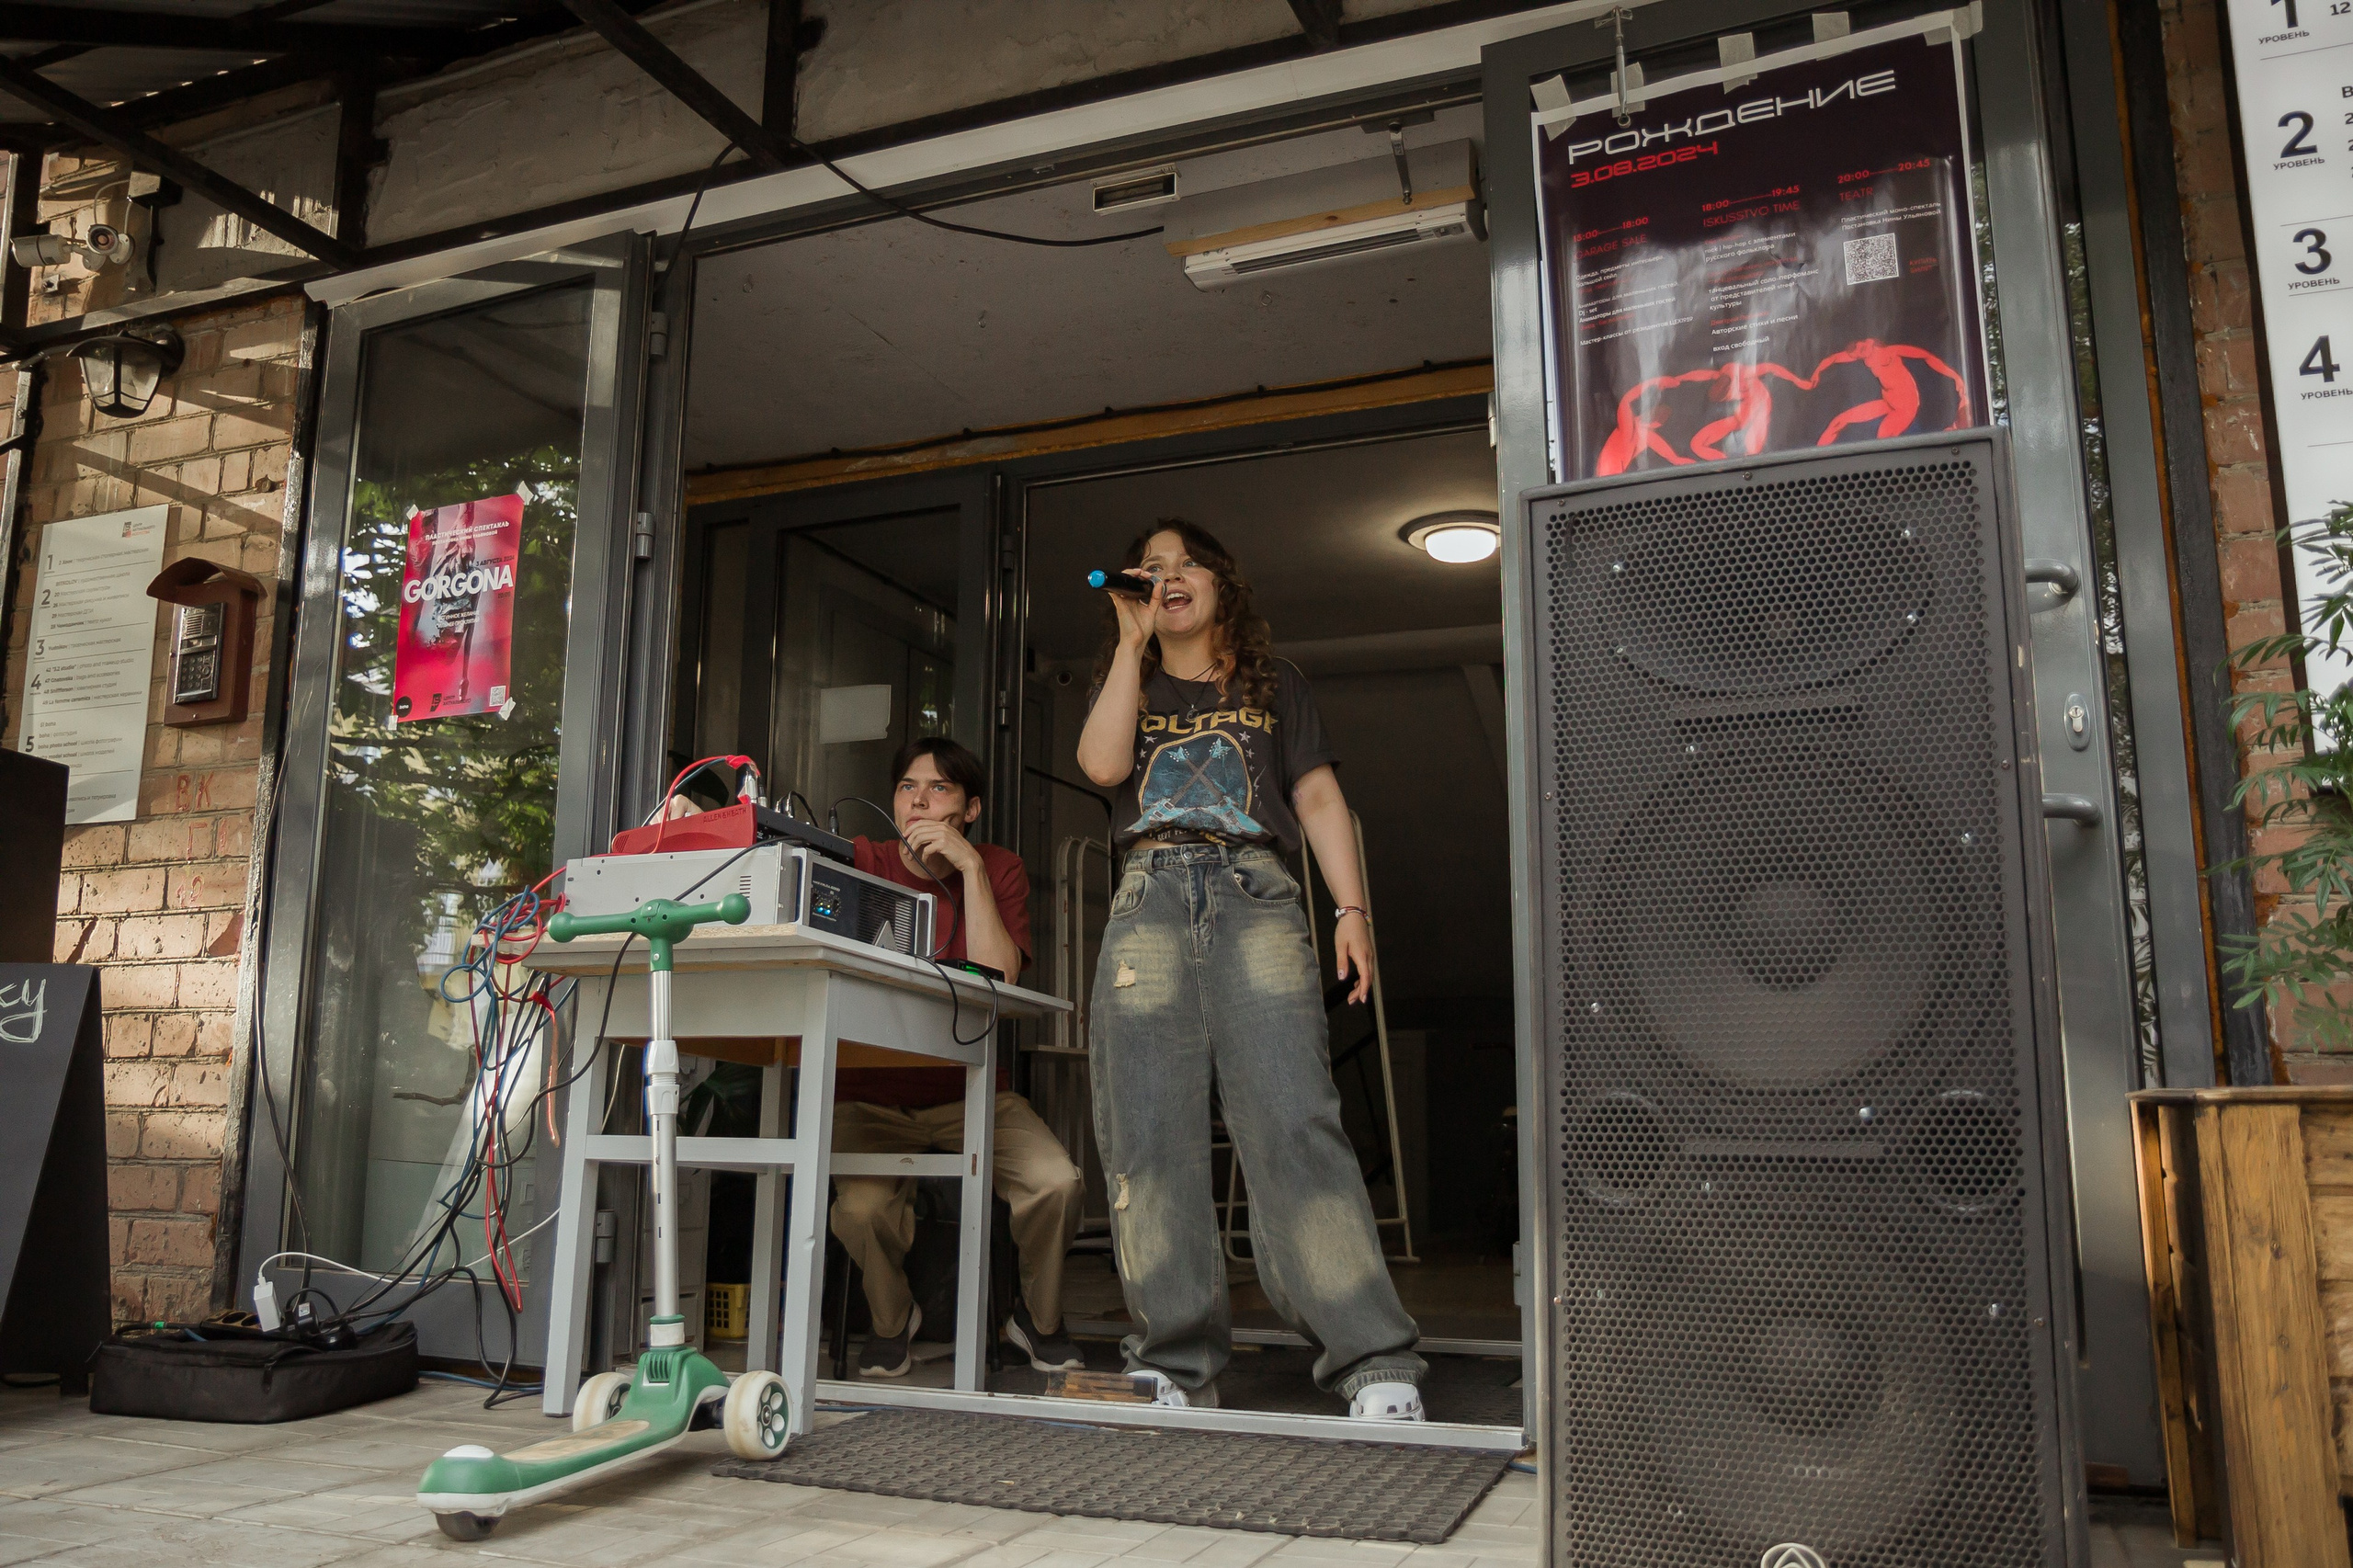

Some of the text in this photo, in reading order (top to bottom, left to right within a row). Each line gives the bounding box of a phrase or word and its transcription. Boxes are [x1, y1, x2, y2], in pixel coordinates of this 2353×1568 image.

[2269, 0, 2299, 28] 1
[2329, 2, 2351, 17] 12
[2258, 29, 2310, 44] УРОВЕНЬ
[1568, 70, 1896, 165] РОЖДЕНИЕ
[2278, 110, 2318, 159] 2
[1570, 141, 1719, 188] 3.08.2024
[2273, 157, 2325, 170] УРОВЕНЬ
[1838, 187, 1873, 202] TEATR
[1702, 200, 1801, 228] ISKUSSTVO TIME
[1840, 209, 1888, 223] Пластический
[1841, 219, 1881, 231] Постановка
[1903, 210, 1941, 220] Ульяновой
[1574, 233, 1647, 260] GARAGE SALE
[1704, 245, 1718, 254] rock
[1753, 232, 1796, 244] элементами
[2292, 228, 2332, 275] 3
[1705, 244, 1775, 263] русского фольклора
[1600, 262, 1630, 274] предметы
[1708, 278, 1759, 294] танцевальный
[1760, 268, 1819, 285] соло-перфоманс
[2288, 277, 2340, 290] УРОВЕНЬ
[1720, 284, 1776, 301] представителей
[1709, 301, 1742, 311] культуры
[1579, 312, 1611, 324] Аниматоры
[1711, 324, 1748, 335] Авторские
[1748, 320, 1769, 329] стихи
[1776, 314, 1799, 324] песни
[1580, 330, 1623, 346] Мастер-классы
[1712, 335, 1769, 352] вход свободный
[2299, 335, 2340, 382] 4
[2301, 388, 2353, 400] УРОВЕНЬ
[425, 520, 510, 540] ПЛАСТИЧЕСКИЙ СПЕКТАКЛЬ
[48, 554, 53, 570] 1
[404, 564, 514, 604] GORGONA
[41, 588, 51, 606] 2
[35, 639, 45, 656] 3
[30, 674, 42, 690] 4
[1138, 707, 1279, 735] OLTAGE
[25, 735, 35, 753] 5
